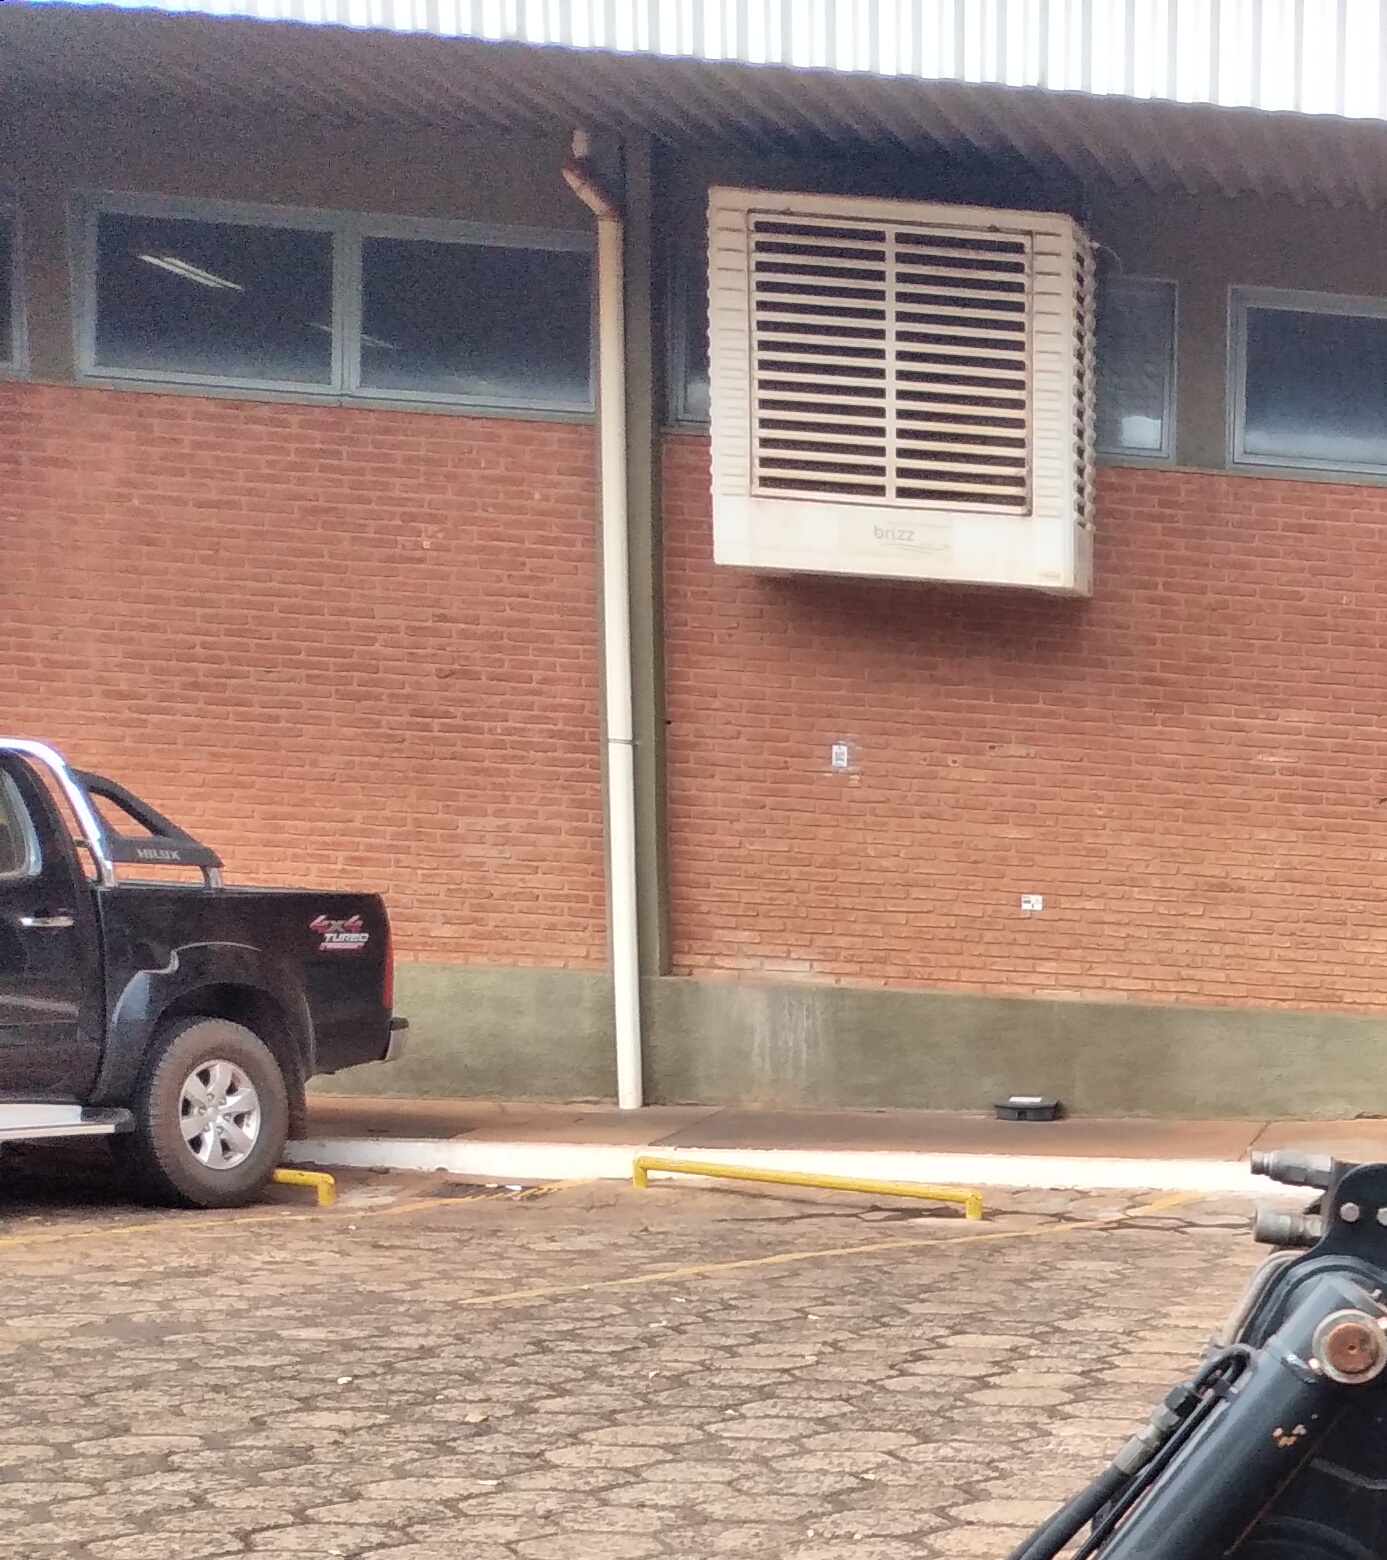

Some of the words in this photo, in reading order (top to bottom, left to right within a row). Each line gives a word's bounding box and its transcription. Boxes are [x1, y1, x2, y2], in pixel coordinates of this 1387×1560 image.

[874, 525, 915, 541] brizz
[136, 848, 180, 860] HILUX
[324, 933, 369, 943] TURBO
